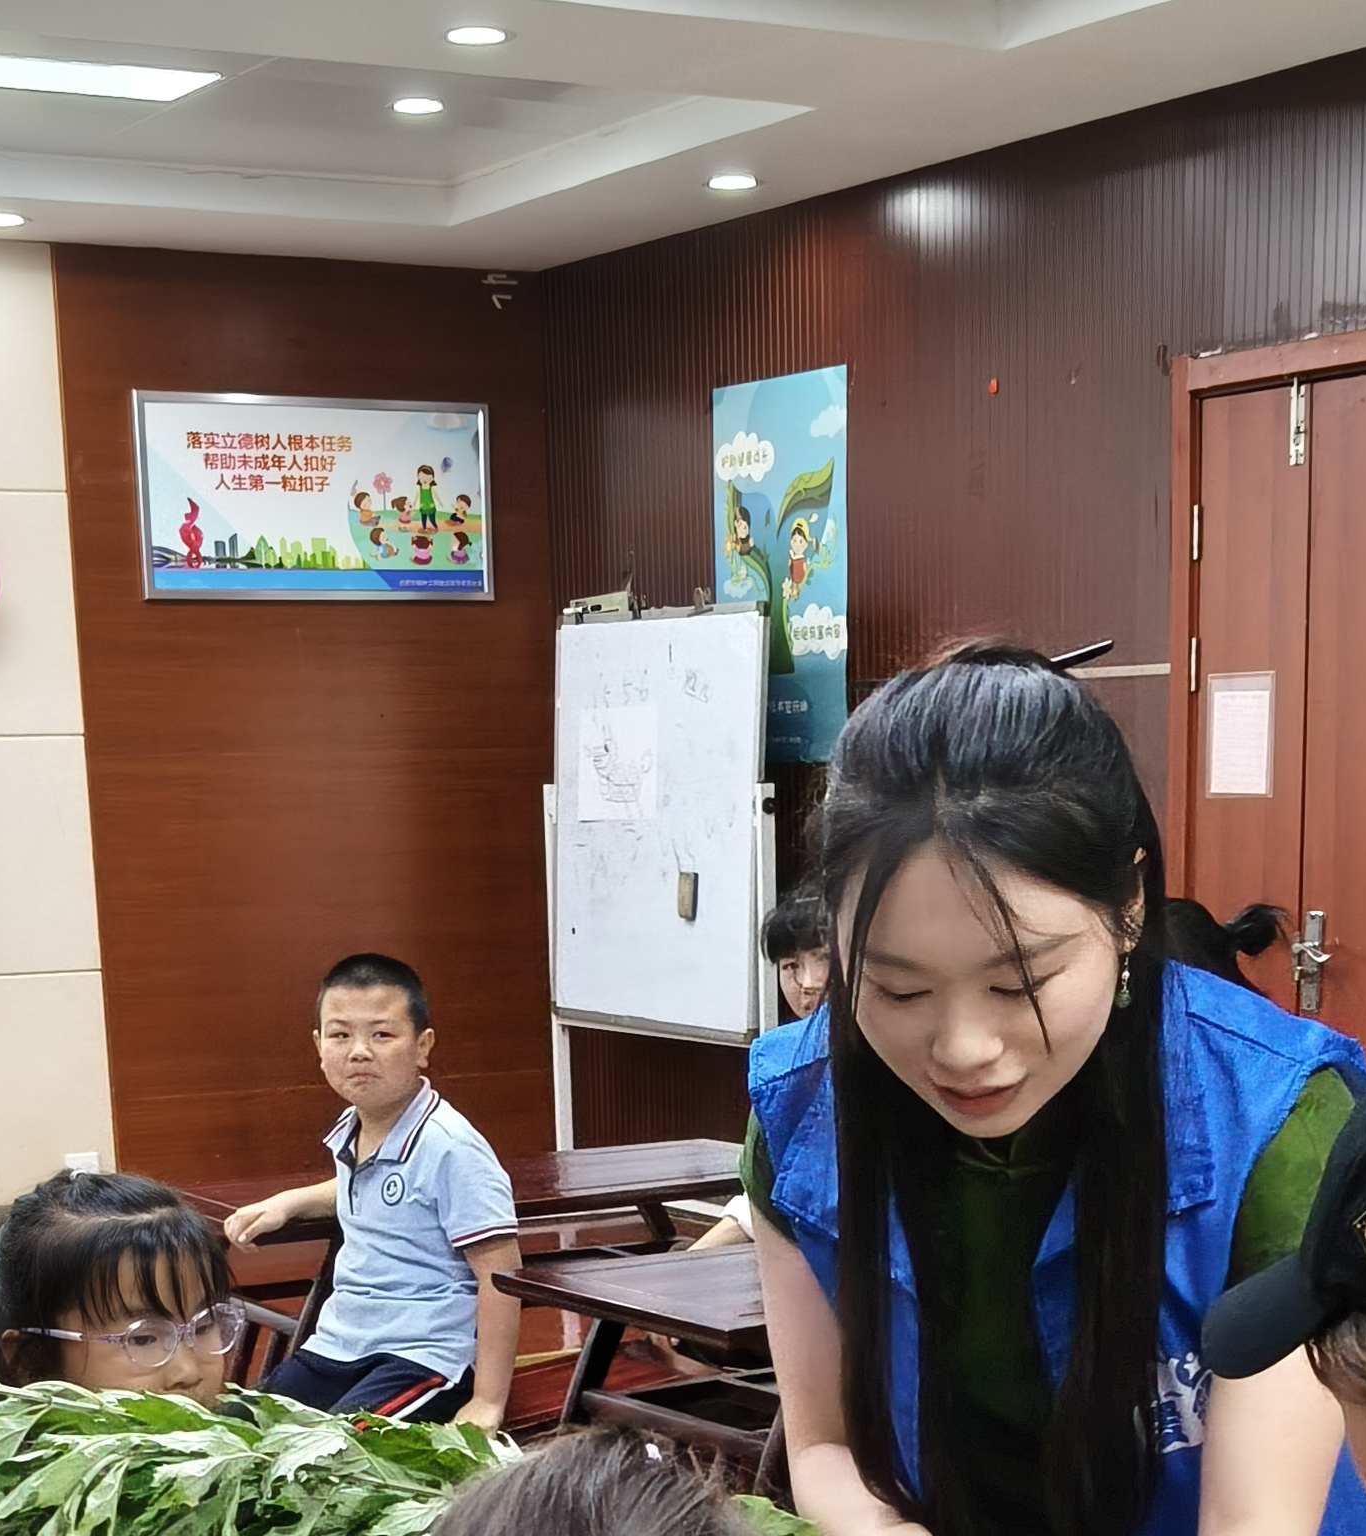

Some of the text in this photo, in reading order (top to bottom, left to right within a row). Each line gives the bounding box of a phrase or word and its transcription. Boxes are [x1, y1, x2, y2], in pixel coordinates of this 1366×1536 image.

[186, 431, 353, 453] 落实立德树人根本任务
[203, 453, 337, 473] 帮助未成年人扣好
[215, 474, 330, 493] 人生第一粒扣子
